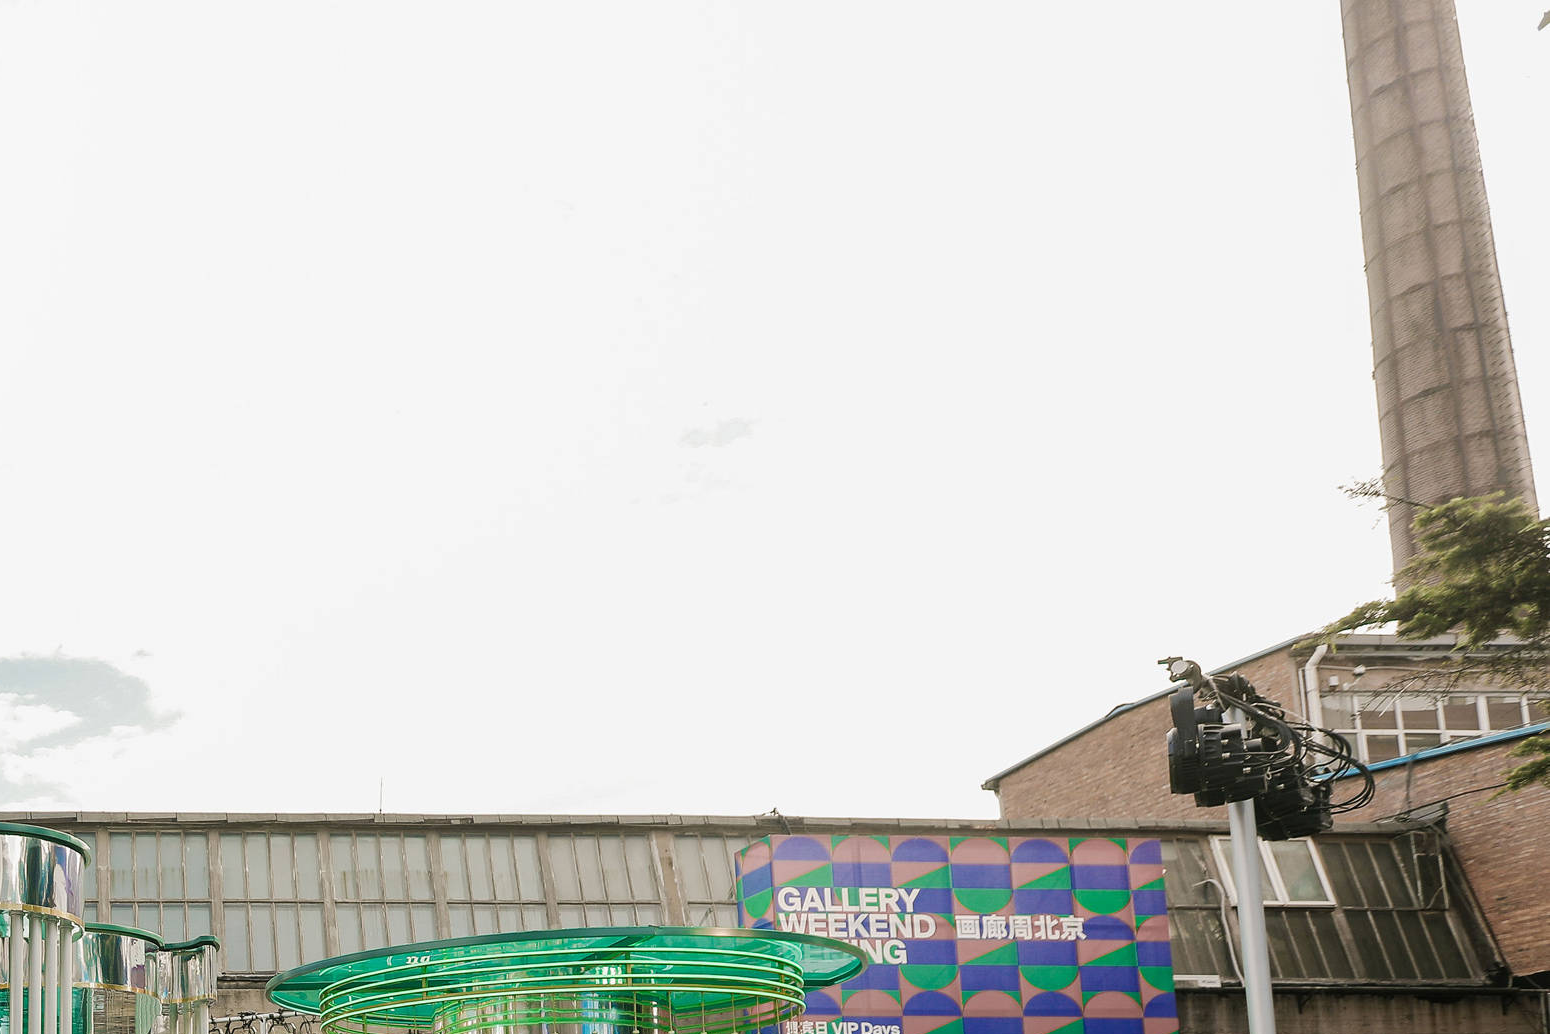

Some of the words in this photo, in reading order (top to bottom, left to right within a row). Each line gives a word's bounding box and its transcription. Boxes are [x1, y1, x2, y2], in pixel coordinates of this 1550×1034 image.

[778, 887, 921, 913] GALLERY
[778, 912, 937, 939] WEEKEND
[954, 914, 1087, 940] 画廊周北京
